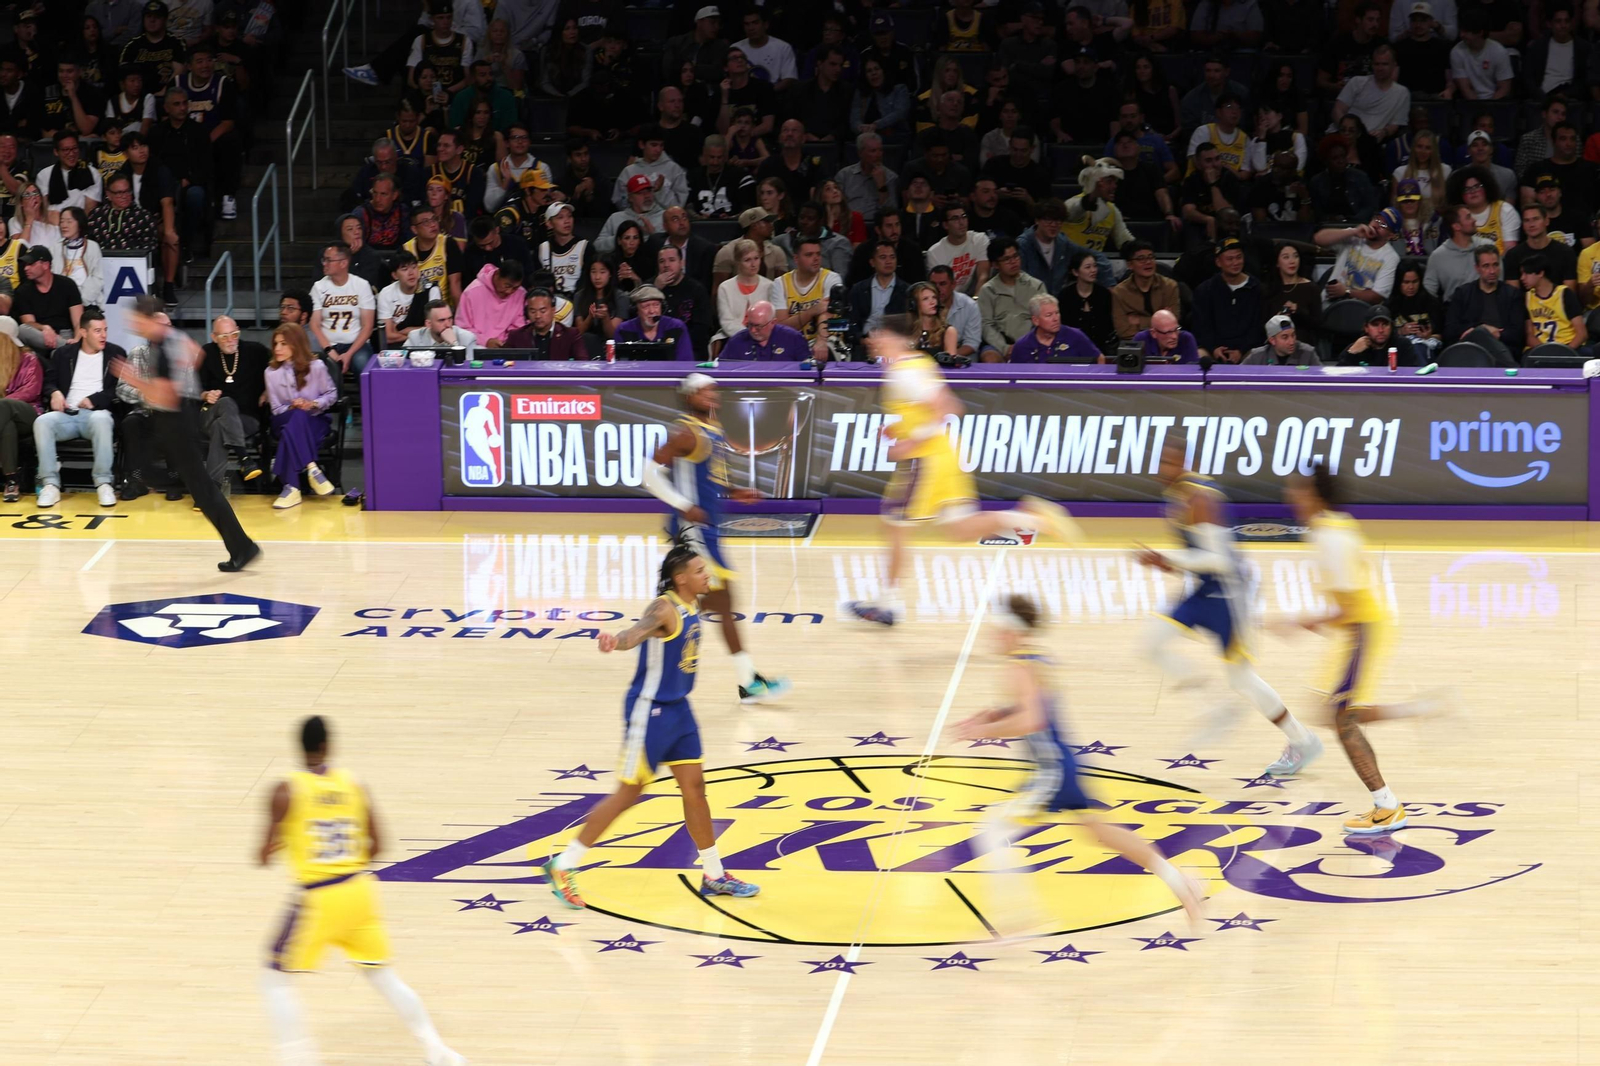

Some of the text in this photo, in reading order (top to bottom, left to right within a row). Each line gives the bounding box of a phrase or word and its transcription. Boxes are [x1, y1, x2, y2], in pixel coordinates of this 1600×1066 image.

[698, 187, 732, 215] 34
[107, 267, 145, 304] A
[323, 294, 359, 308] LAKERS
[330, 311, 353, 331] 77
[1532, 321, 1557, 343] 77
[516, 398, 596, 415] Emirates
[829, 413, 1401, 478] THE OURNAMENT TIPS OCT 31
[1430, 410, 1562, 461] prime
[511, 423, 588, 486] NBA
[468, 465, 489, 481] NBA
[354, 607, 824, 623] crypto.om
[340, 625, 602, 640] ARENA
[725, 795, 945, 811] LOS
[372, 793, 1542, 903] LAKERS
[471, 899, 498, 907] '20
